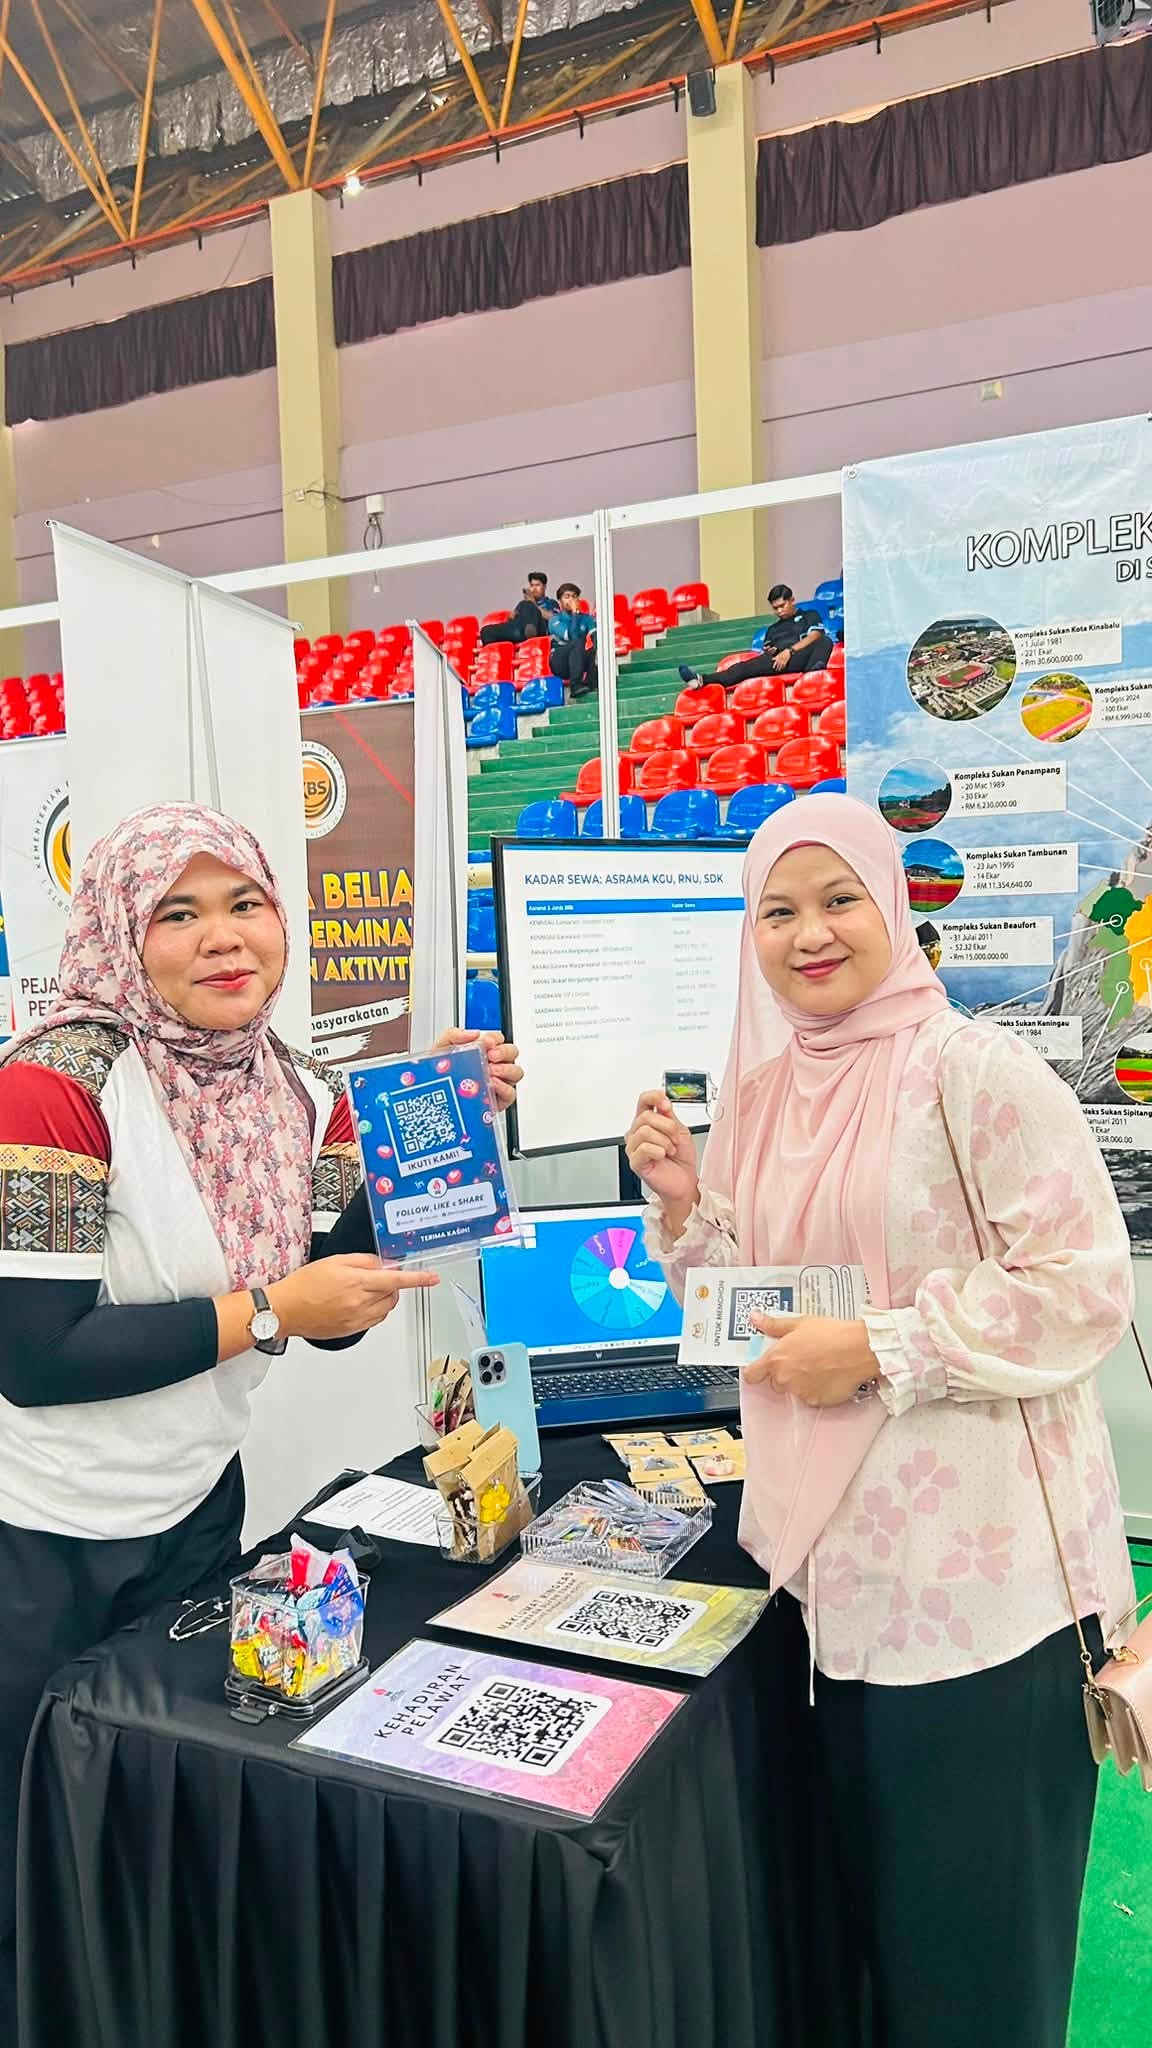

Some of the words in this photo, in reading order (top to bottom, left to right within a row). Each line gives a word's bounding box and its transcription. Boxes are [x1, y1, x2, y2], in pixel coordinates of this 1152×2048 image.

[1116, 558, 1141, 582] DI
[1014, 630, 1047, 641] Kompleks
[1048, 627, 1070, 637] Sukan
[1071, 625, 1087, 634] Kota
[1088, 622, 1120, 632] Kinabalu
[1047, 637, 1062, 646] 1981
[1024, 649, 1037, 658] 221
[1038, 647, 1052, 656] Ekar
[1094, 685, 1129, 696] Kompleks
[1130, 682, 1152, 692] Sukan
[954, 771, 990, 781] Kompleks
[991, 769, 1015, 779] Sukan
[1016, 767, 1061, 777] Penampang
[304, 780, 327, 796] BS
[965, 782, 974, 791] 20
[989, 780, 1005, 789] 1989
[965, 792, 973, 800] 30
[974, 791, 988, 799] Ekar
[966, 852, 1002, 862] Kompleks
[1003, 850, 1027, 859] Sukan
[1028, 848, 1068, 857] Tambunan
[976, 862, 985, 870] 23
[986, 861, 997, 870] Jun
[999, 860, 1015, 869] 1995
[525, 873, 565, 886] KADAR
[568, 873, 602, 886] SEWA:
[604, 873, 650, 886] ASRAMA
[678, 872, 702, 886] RNU,
[703, 871, 724, 884] SDK
[977, 872, 985, 880] 14
[986, 871, 1000, 879] Ekar
[976, 881, 987, 889] RM
[311, 916, 412, 949] ERMINA
[943, 922, 979, 932] Kompleks
[980, 922, 1002, 930] Sukan
[1003, 921, 1037, 930] Beaufort
[323, 955, 411, 982] AKTIVIT
[21, 977, 60, 994] PEJA
[29, 1000, 53, 1017] PE
[1037, 1020, 1070, 1028] Keningau
[1100, 1108, 1122, 1116] Sukan
[1123, 1109, 1152, 1118] Sipitang
[1095, 1126, 1110, 1134] Ekar
[407, 1157, 432, 1171] IKUTI
[432, 1150, 460, 1165] KAMI!
[432, 1199, 451, 1211] LIKE
[458, 1194, 484, 1206] SHARE
[420, 1231, 446, 1243] TERIMA
[716, 1280, 725, 1320] MEMOHON
[714, 1321, 722, 1347] UNTUK
[374, 1664, 462, 1739] KEHADIRAN
[401, 1674, 471, 1736] PELAWAT
